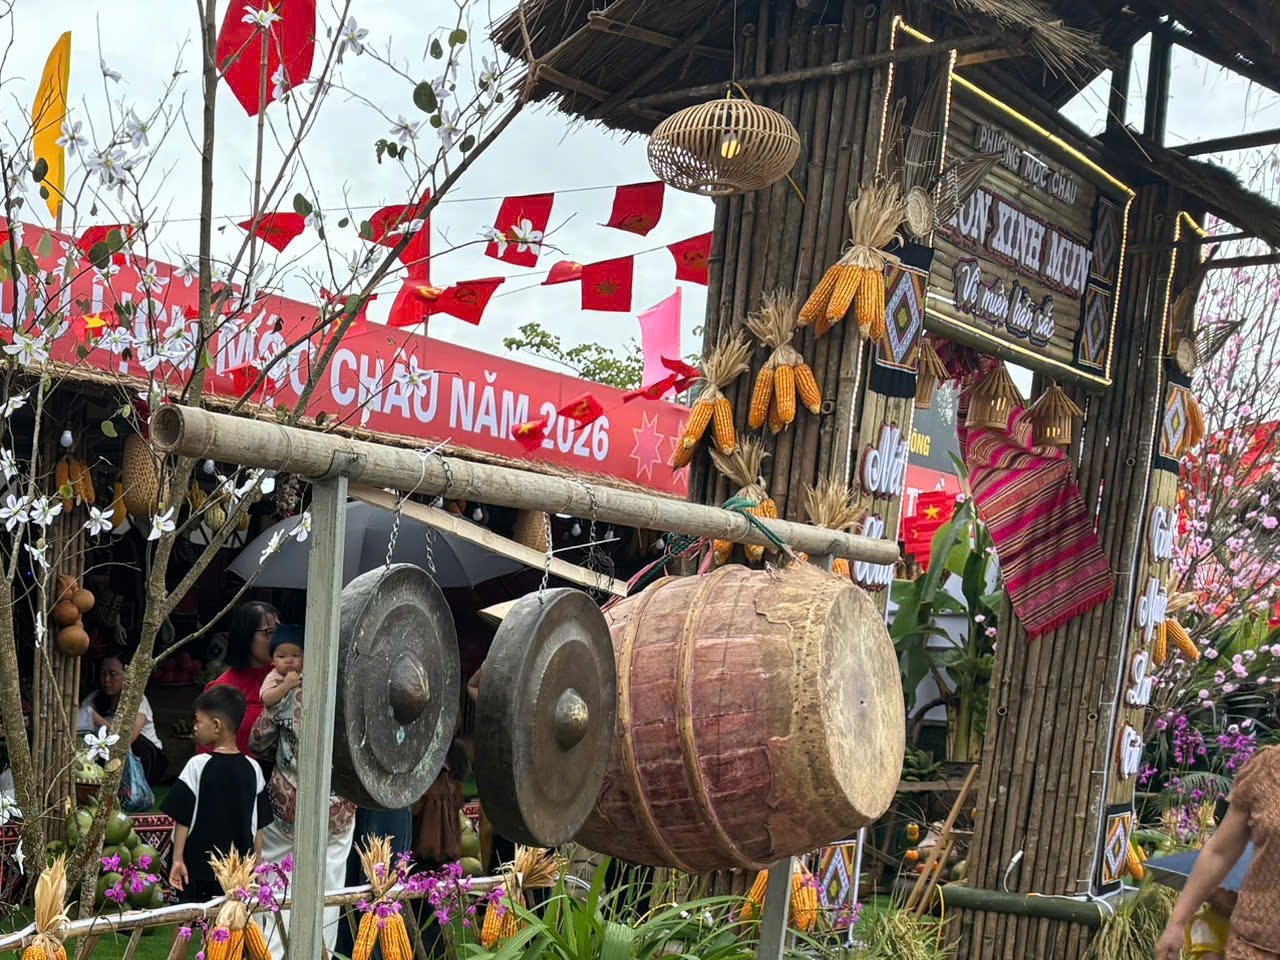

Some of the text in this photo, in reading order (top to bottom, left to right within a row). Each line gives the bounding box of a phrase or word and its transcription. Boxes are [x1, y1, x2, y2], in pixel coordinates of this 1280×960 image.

[991, 201, 1045, 272] XINH
[1046, 231, 1093, 294] MUN
[330, 347, 440, 423] CHÂU
[449, 370, 530, 441] NĂM
[539, 402, 610, 462] 2026
